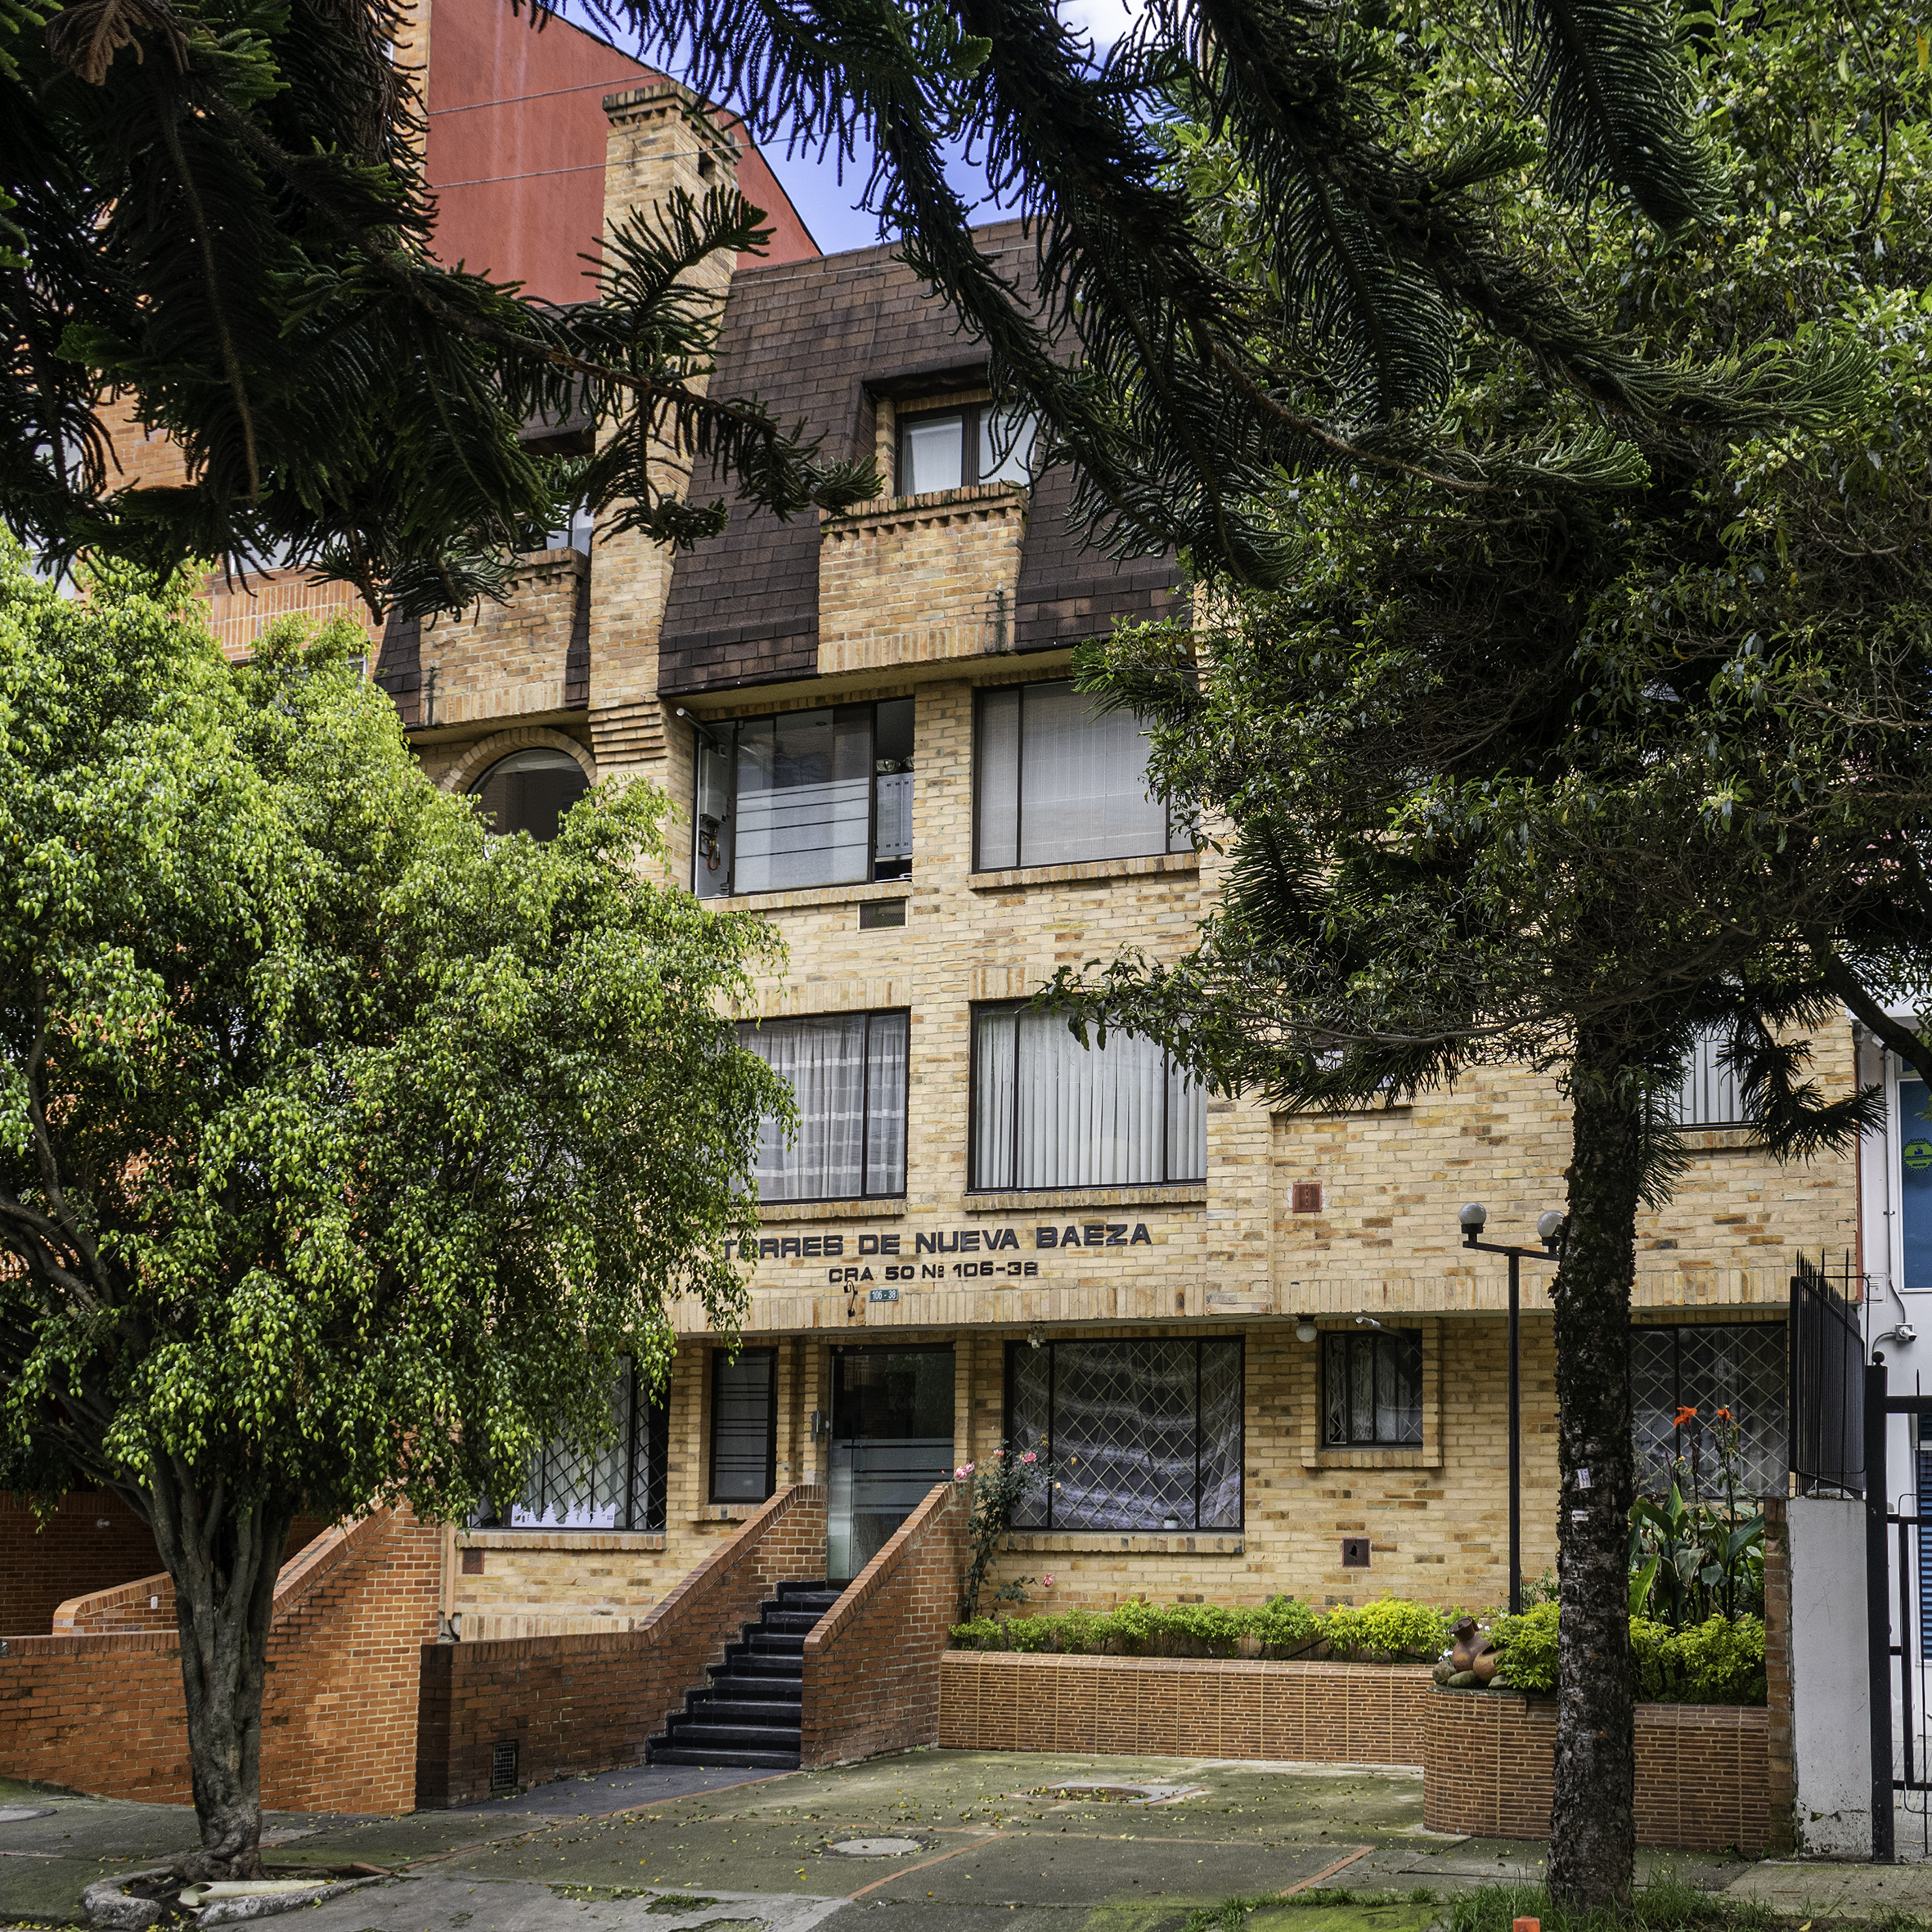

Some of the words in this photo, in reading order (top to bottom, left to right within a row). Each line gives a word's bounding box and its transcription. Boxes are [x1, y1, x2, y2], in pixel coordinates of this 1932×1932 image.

[718, 1234, 843, 1260] TORRES
[858, 1234, 901, 1255] DE
[915, 1229, 1020, 1253] NUEVA
[1036, 1224, 1152, 1249] BAEZA
[829, 1266, 874, 1283] CRA
[884, 1265, 914, 1281] 50
[952, 1260, 1039, 1278] 106-38
